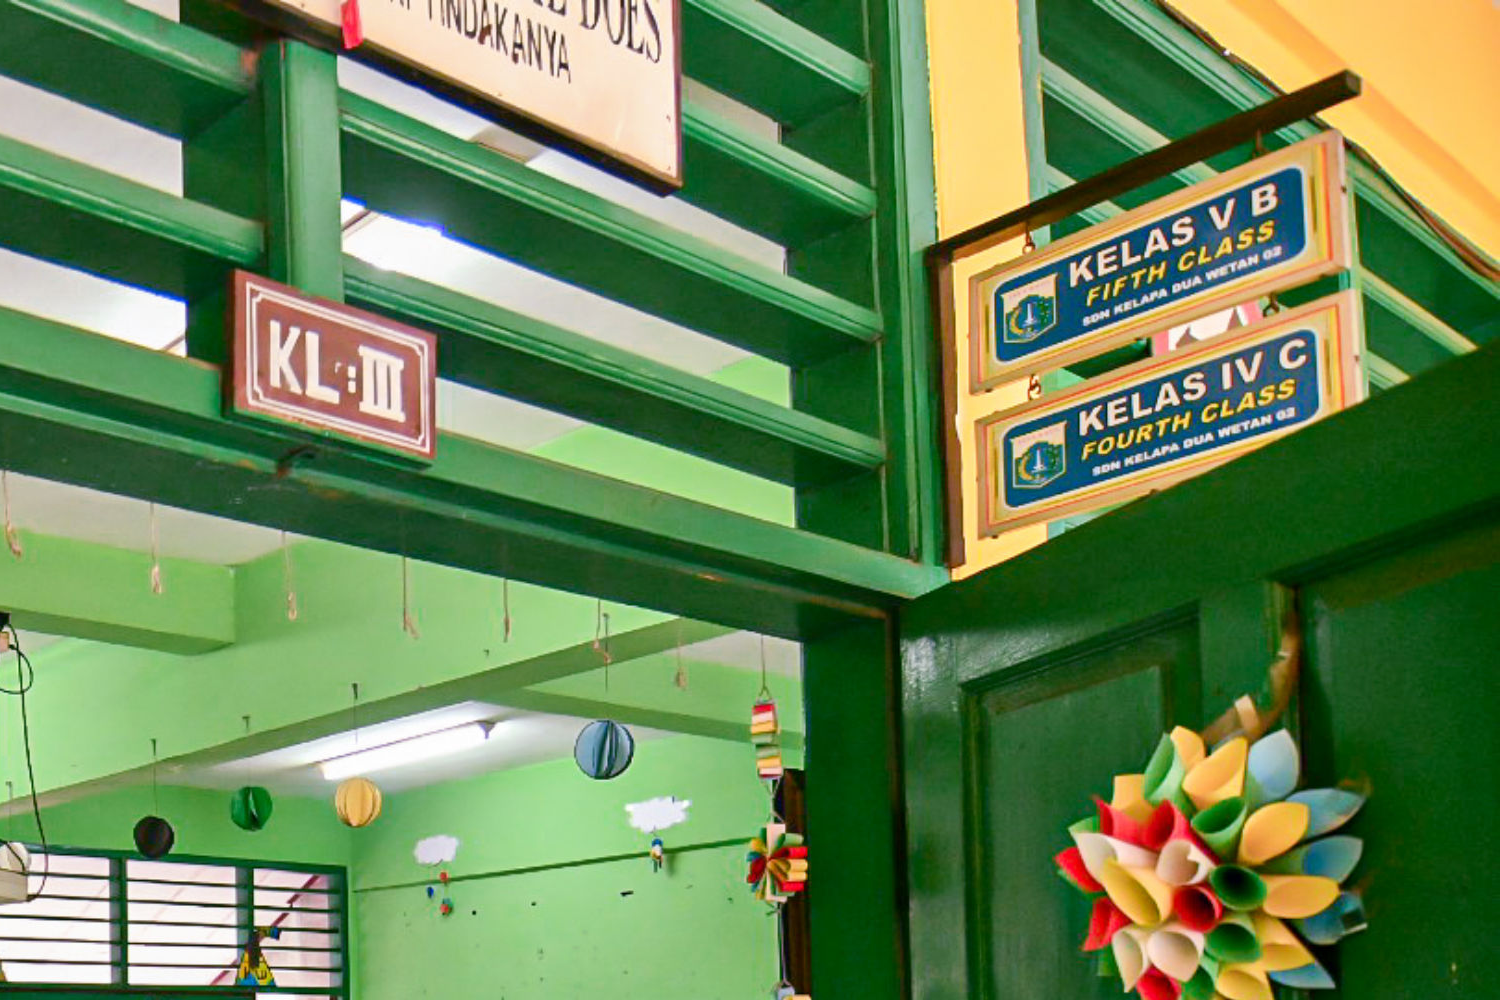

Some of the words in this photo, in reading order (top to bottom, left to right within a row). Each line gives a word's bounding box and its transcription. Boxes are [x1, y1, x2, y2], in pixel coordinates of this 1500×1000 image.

[1069, 216, 1195, 286] KELAS
[1208, 198, 1235, 231] V
[1251, 183, 1278, 217] B
[1085, 260, 1168, 307] FIFTH
[1177, 220, 1275, 272] CLASS
[1113, 288, 1168, 315] KELAPA
[1171, 276, 1203, 294] DUA
[1205, 253, 1260, 281] WETAN
[1078, 372, 1206, 436] KELAS
[1221, 351, 1263, 389] IV
[1279, 339, 1307, 369] C
[1080, 411, 1192, 460] FOURTH
[1200, 379, 1297, 424] CLASS
[1124, 442, 1180, 467] KELAPA
[1183, 431, 1215, 449] DUA
[1218, 414, 1273, 438] WETAN
